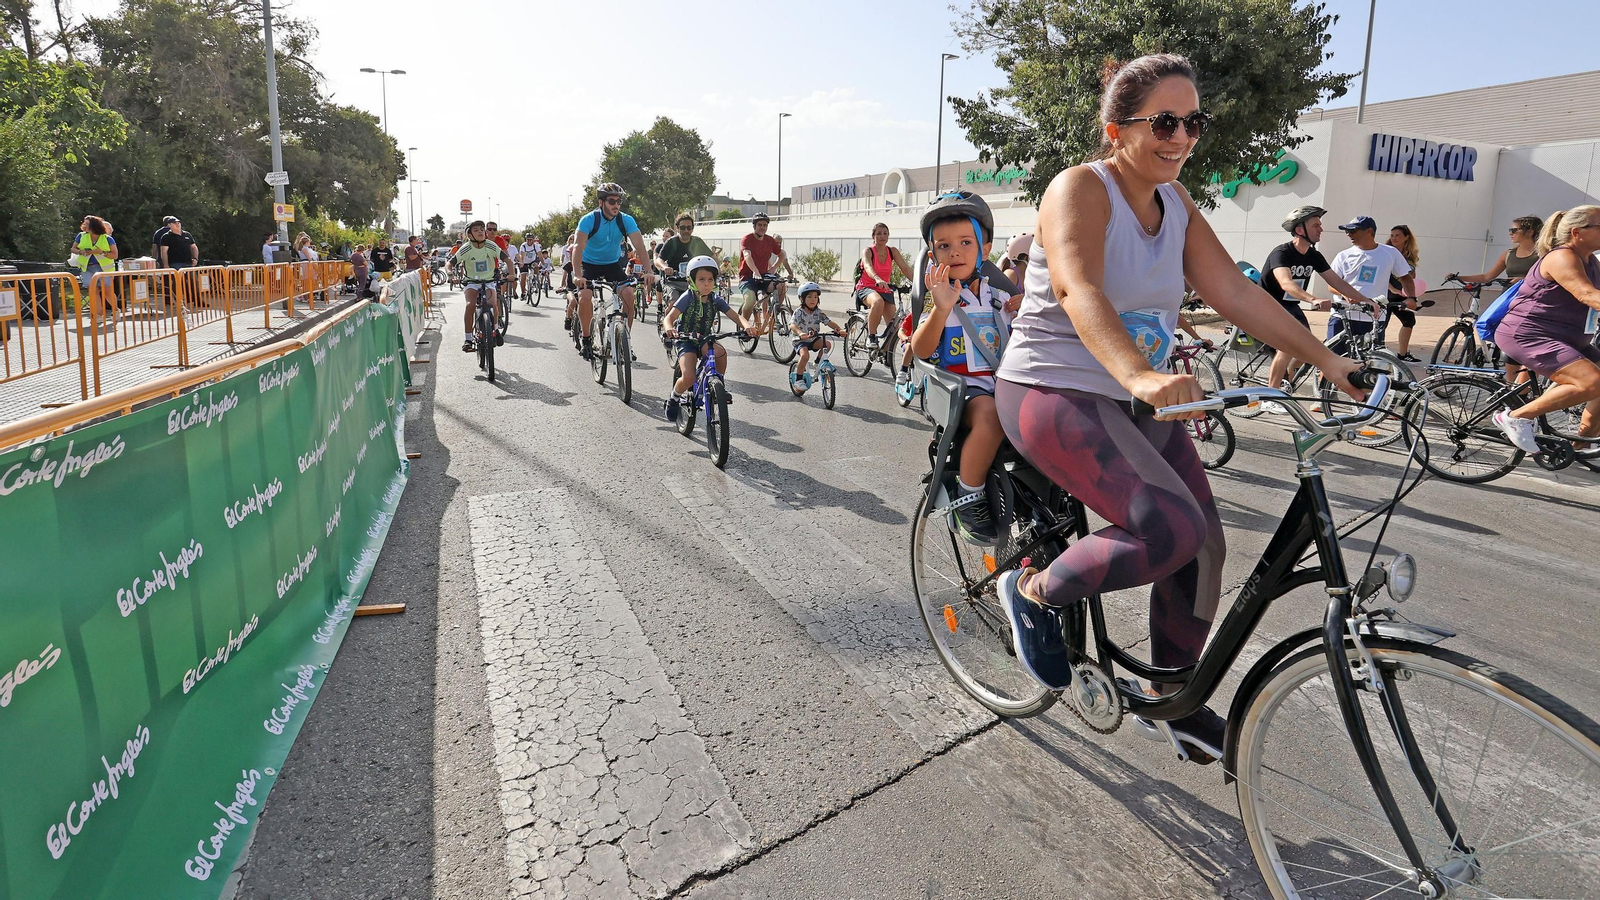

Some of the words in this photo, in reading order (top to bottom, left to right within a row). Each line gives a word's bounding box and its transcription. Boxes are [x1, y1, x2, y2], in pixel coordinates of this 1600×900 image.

[1369, 133, 1478, 181] HIPERCOR
[811, 182, 856, 200] HIPERCOR
[259, 373, 267, 394] El
[266, 370, 281, 390] Corte
[280, 361, 300, 391] Inglés
[167, 409, 180, 435] El
[180, 404, 207, 430] Corte
[206, 390, 238, 428] Inglés
[0, 458, 58, 496] Corte
[54, 434, 126, 488] Inglés
[224, 507, 237, 529] El
[234, 496, 257, 522] Corte
[253, 477, 283, 515] Inglés
[117, 588, 137, 618] El
[132, 569, 167, 605] Corte
[159, 538, 203, 591] Inglés
[277, 579, 286, 599] El
[283, 566, 299, 591] Corte
[296, 545, 318, 581] Inglés
[0, 643, 61, 708] glés
[182, 668, 196, 694] El
[195, 646, 225, 681] Corte
[223, 613, 259, 664] Inglés
[281, 664, 318, 700] Inglés
[263, 719, 285, 735] El
[271, 695, 299, 723] Corte
[46, 822, 71, 860] El
[66, 779, 109, 835] Corte
[101, 724, 150, 800] Inglés
[214, 768, 261, 825] Inglés
[197, 817, 236, 860] Corte
[184, 856, 214, 881] El
